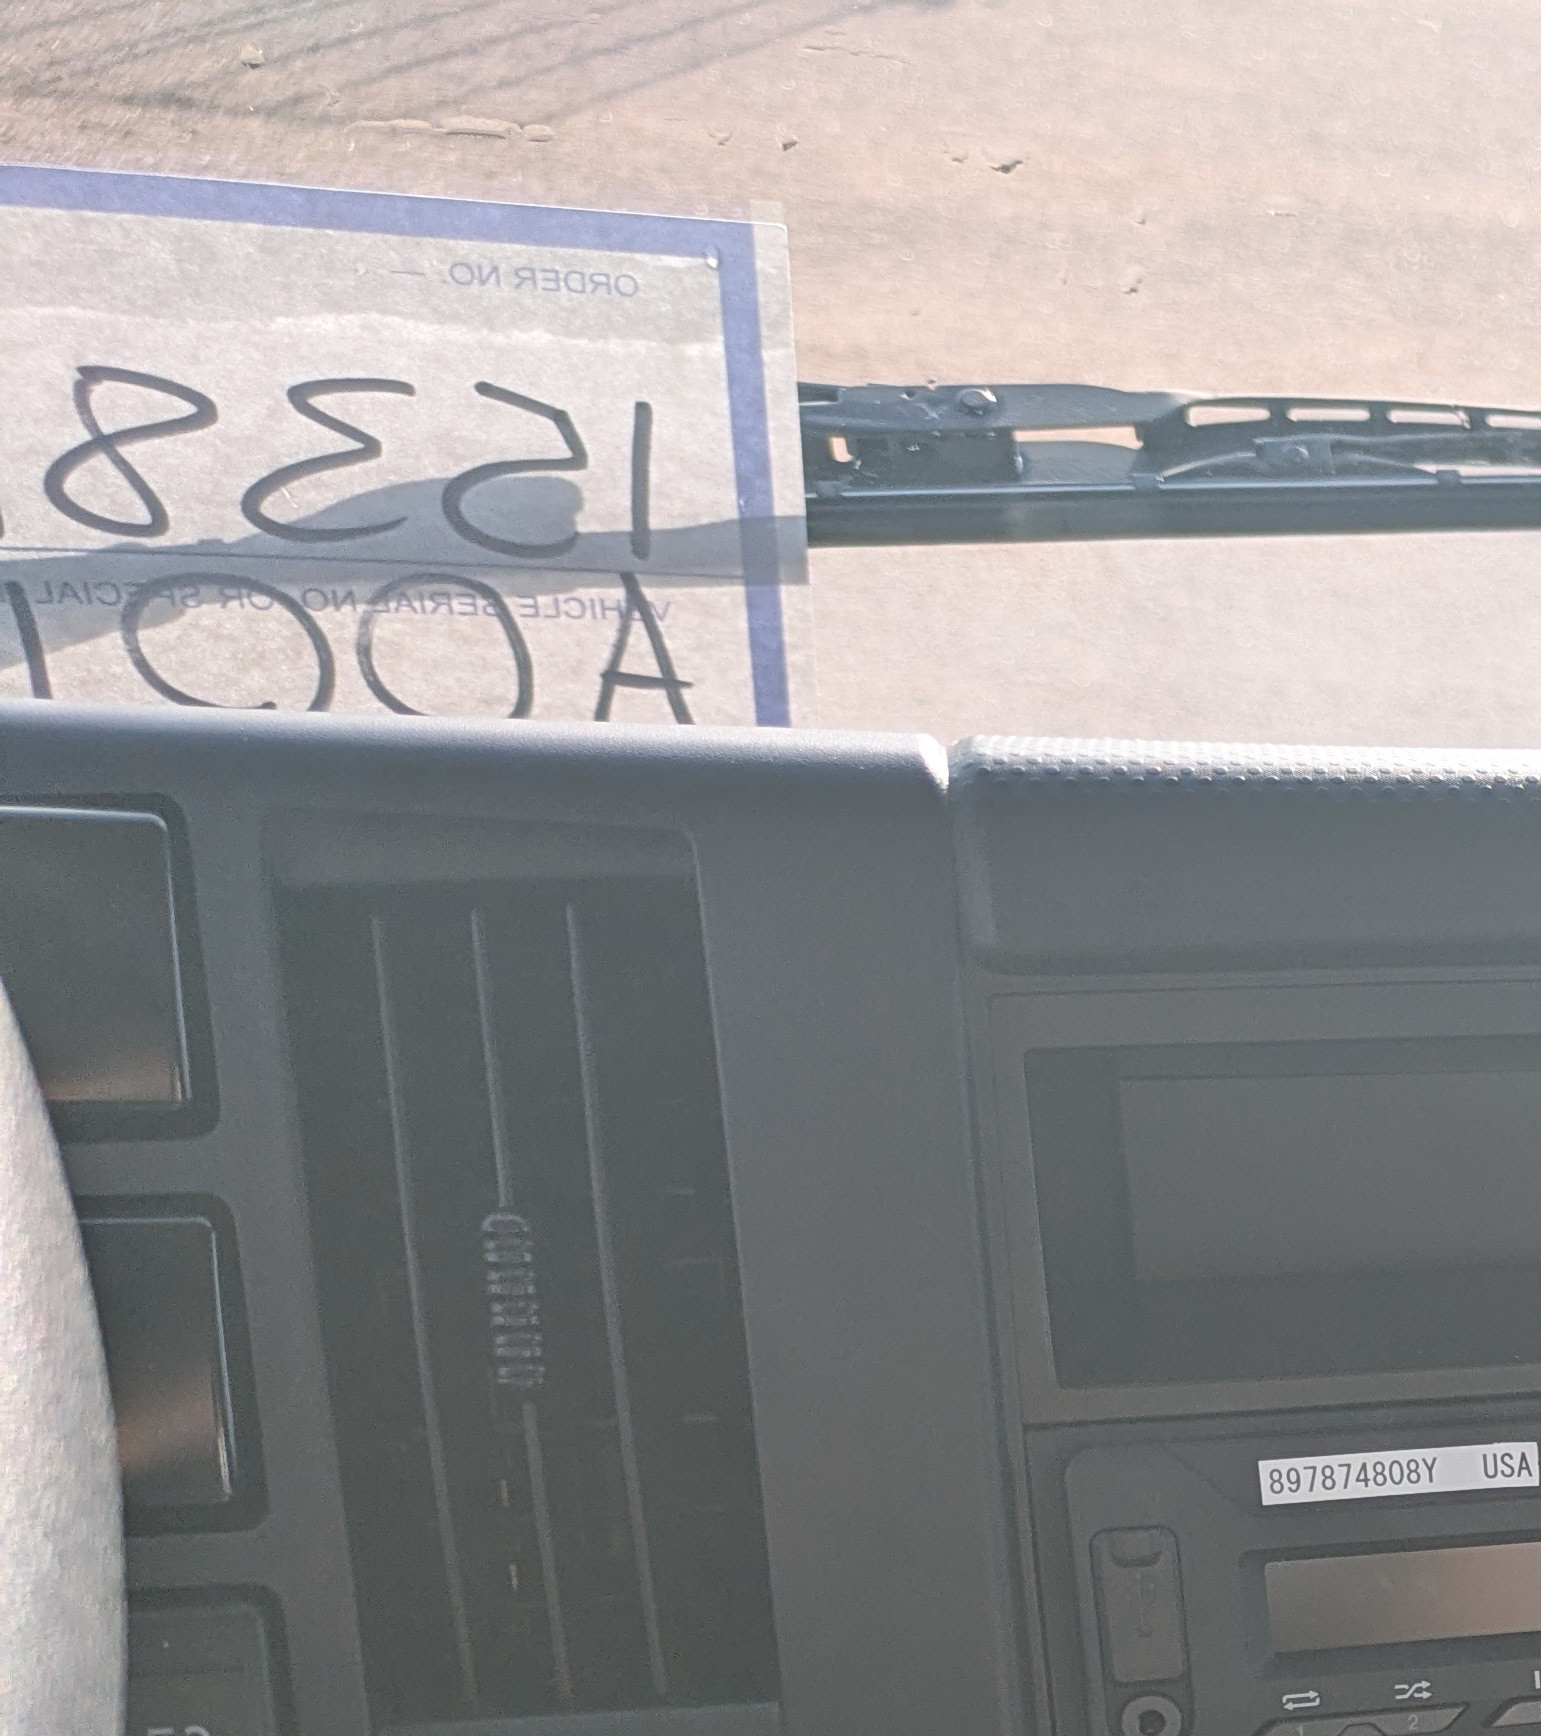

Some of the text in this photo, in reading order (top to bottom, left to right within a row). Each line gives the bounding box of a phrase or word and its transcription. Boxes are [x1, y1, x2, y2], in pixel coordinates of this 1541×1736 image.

[1268, 1451, 1534, 1495] 897874808Y USA
[1407, 1713, 1420, 1732] 2
